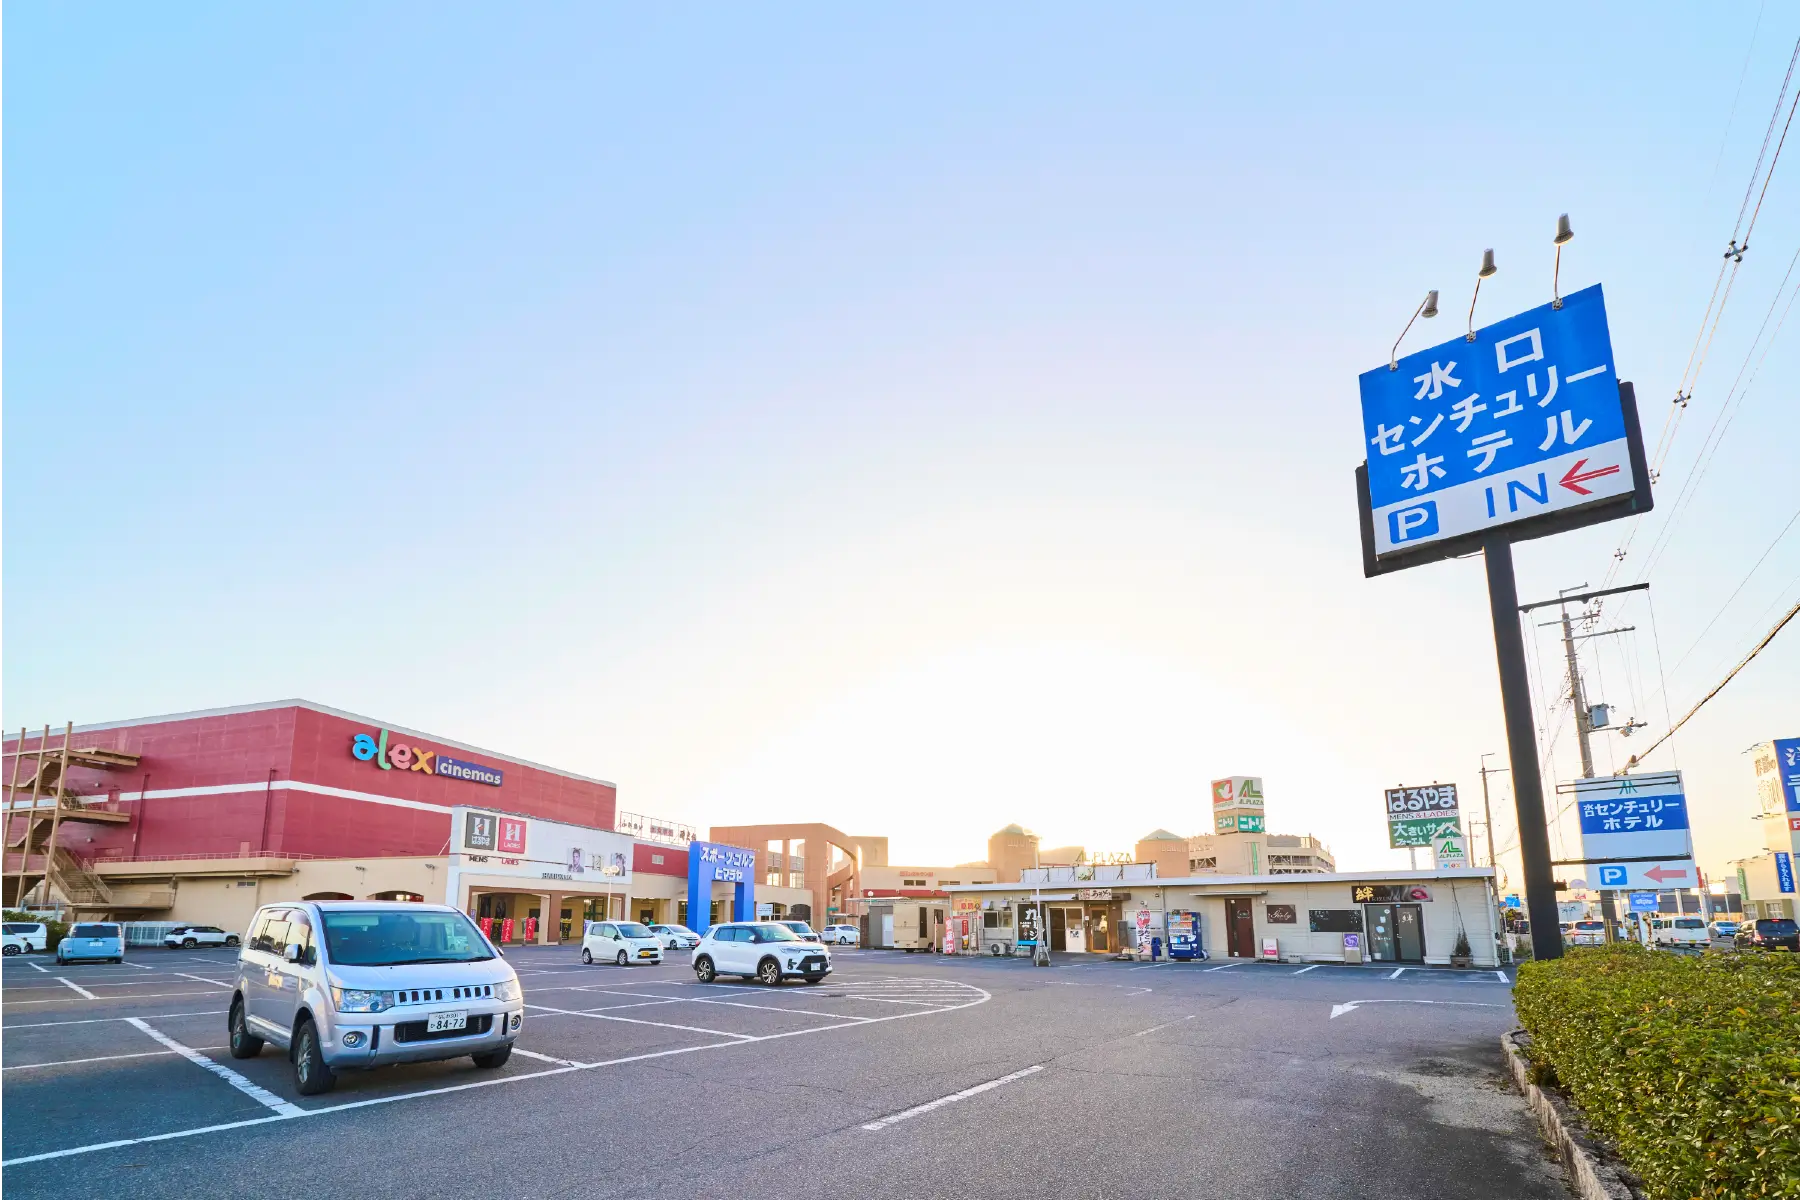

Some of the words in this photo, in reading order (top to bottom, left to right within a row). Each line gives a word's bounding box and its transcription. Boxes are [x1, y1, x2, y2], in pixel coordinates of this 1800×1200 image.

[1413, 327, 1545, 401] 水口
[1370, 364, 1607, 456] センチュリー
[1400, 409, 1593, 491] ホテル
[1398, 507, 1429, 540] P
[1485, 472, 1549, 518] IN
[352, 728, 434, 775] alex
[440, 759, 501, 785] cinemas
[1387, 786, 1456, 812] はるやま
[1423, 810, 1457, 818] LADIES
[1240, 817, 1264, 830] ニトリ
[1602, 815, 1664, 830] ホテル
[468, 855, 488, 863] MENS
[501, 858, 519, 866] LADIES
[715, 867, 743, 882] ヒマラヤ
[1603, 868, 1622, 884] P
[436, 1018, 465, 1030] 84-72
